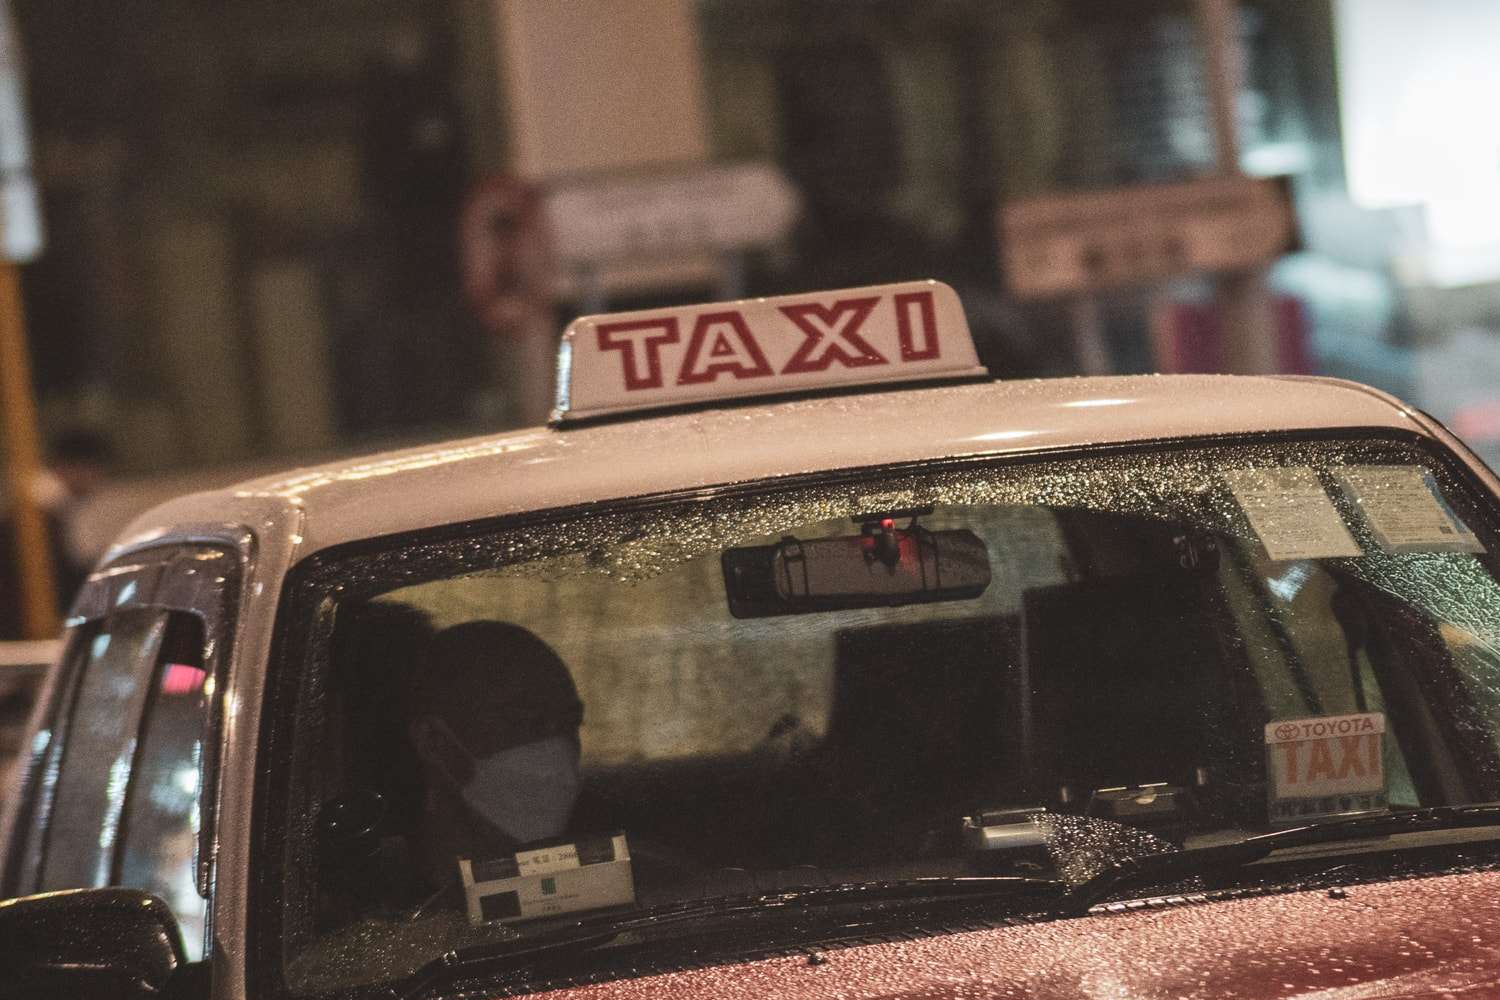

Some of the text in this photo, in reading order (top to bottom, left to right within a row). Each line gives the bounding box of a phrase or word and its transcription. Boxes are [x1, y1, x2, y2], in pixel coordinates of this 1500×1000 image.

[596, 291, 940, 391] TAXI
[1302, 717, 1374, 737] TOYOTA
[1280, 735, 1379, 785] TAXI
